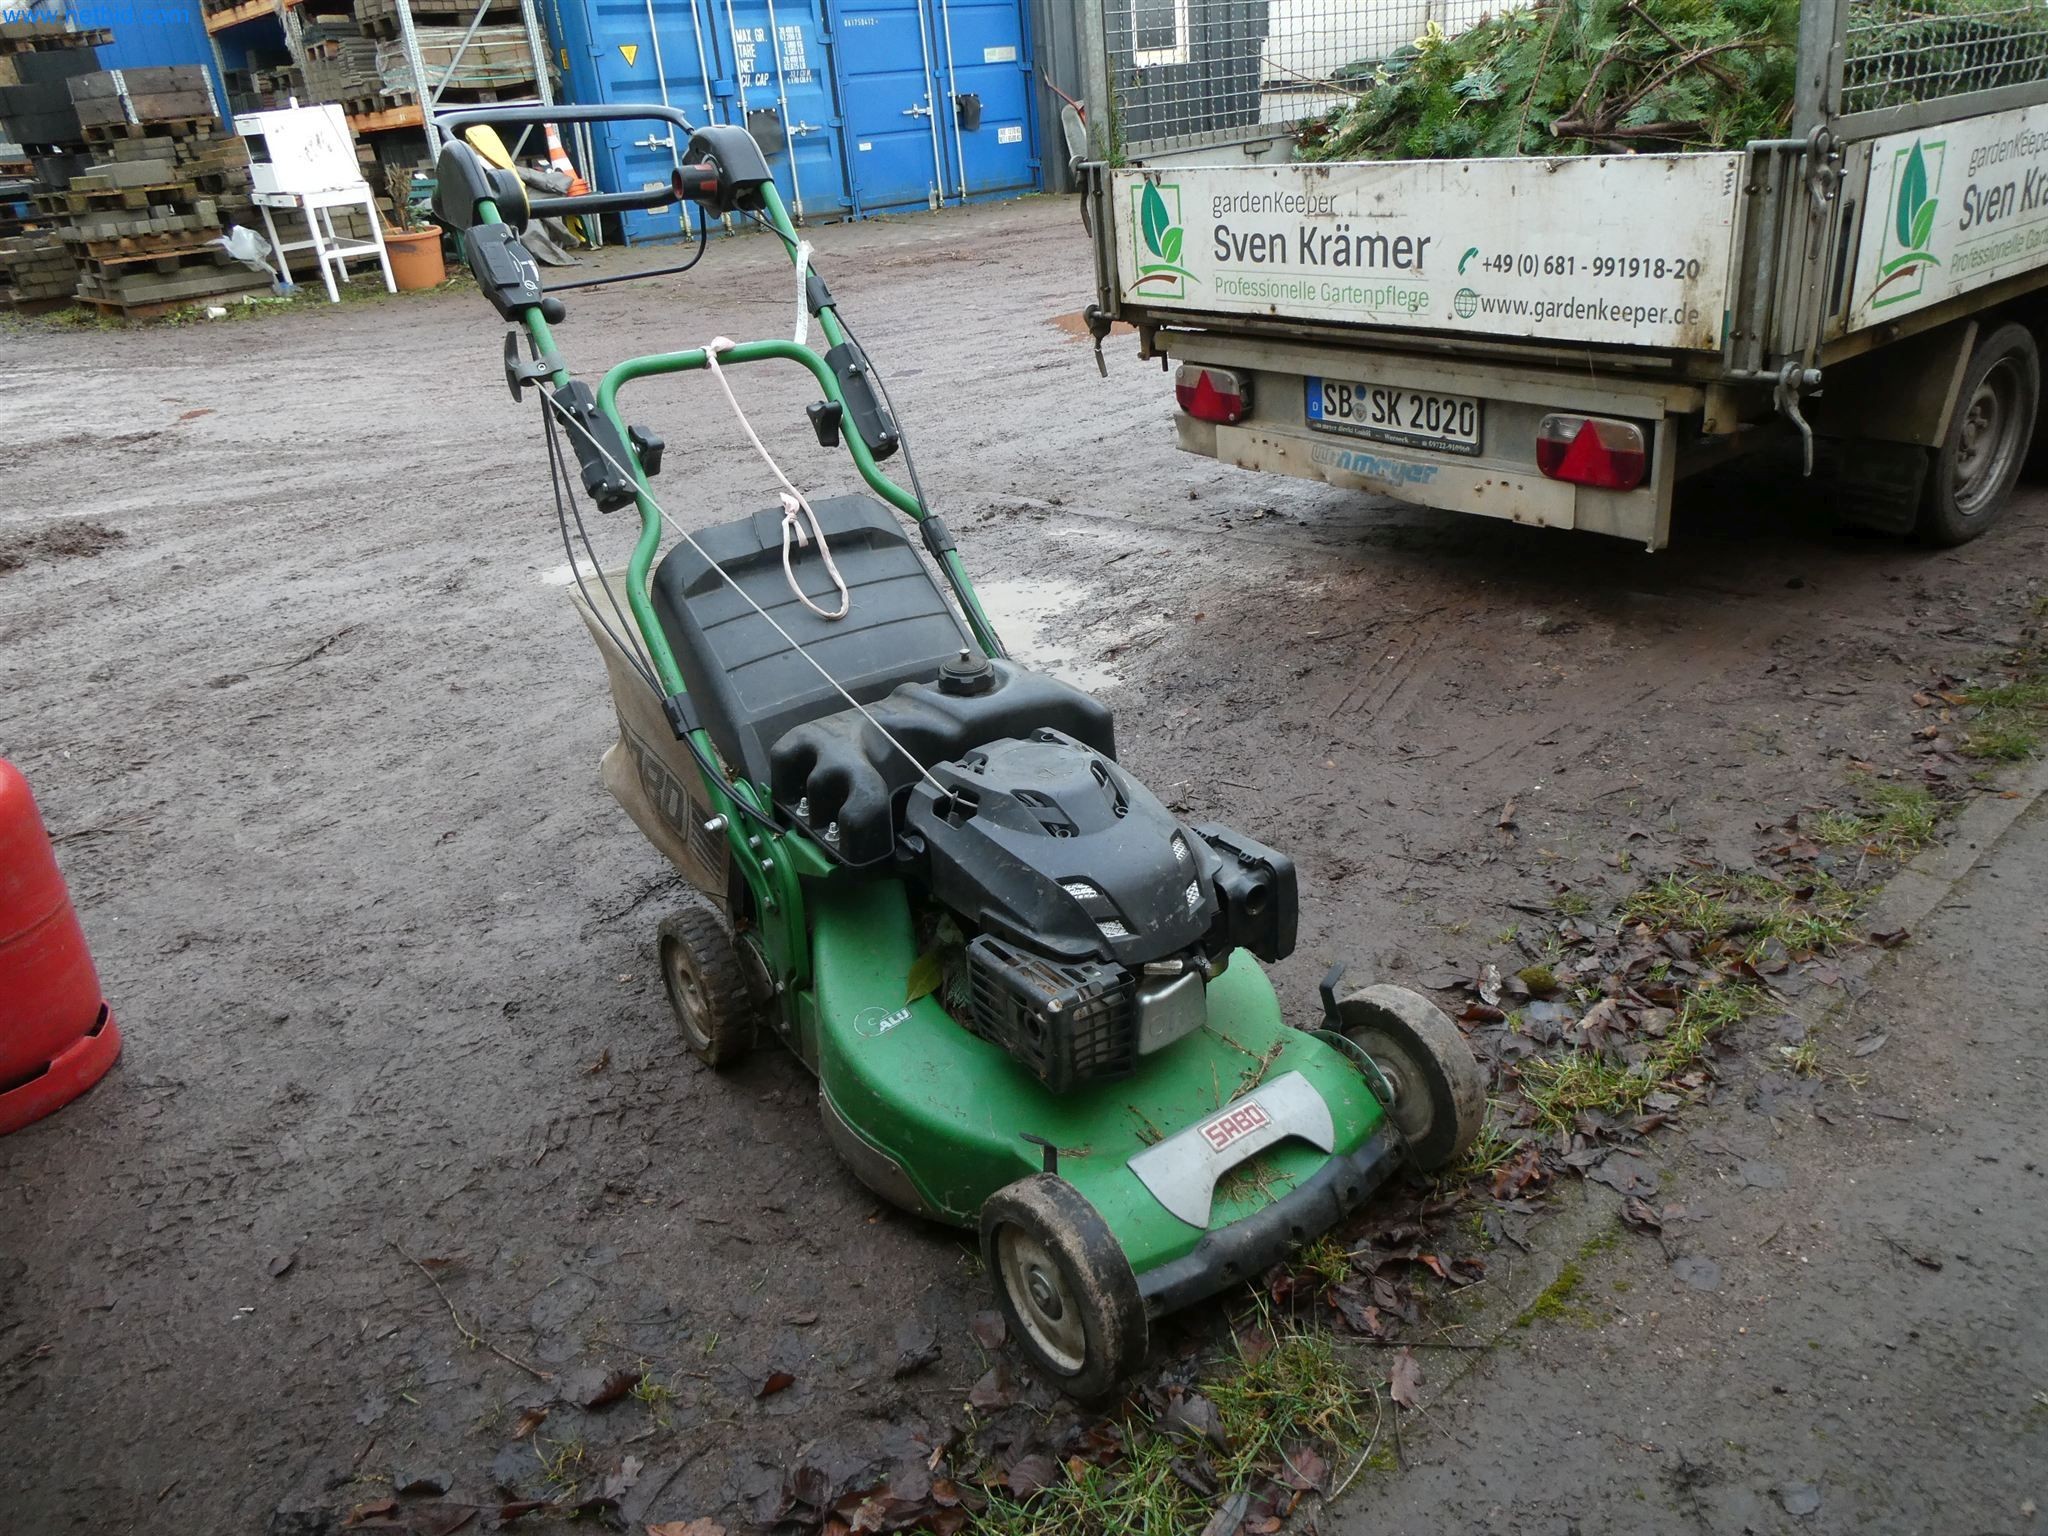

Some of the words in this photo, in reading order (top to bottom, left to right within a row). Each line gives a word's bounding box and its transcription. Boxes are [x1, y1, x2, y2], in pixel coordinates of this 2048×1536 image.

[737, 43, 756, 58] TARE
[740, 59, 754, 73] NET
[1212, 191, 1337, 218] gardenKeeper
[1959, 181, 2016, 231] Sven
[1214, 224, 1286, 263] Sven
[1300, 224, 1431, 270] Krämer
[1951, 231, 2024, 275] Professionelle
[1482, 254, 1512, 274] +49
[1518, 254, 1538, 277] (0)
[1544, 256, 1575, 276] 681
[1593, 257, 1700, 280] 991918-20
[1215, 277, 1316, 300] Professionelle
[1321, 283, 1429, 312] Gartenpflege
[1481, 297, 1700, 328] www.gardenkeeper.de
[1312, 401, 1319, 412] D
[1324, 383, 1352, 418] SB
[1372, 390, 1402, 426] SK
[1410, 395, 1475, 437] 2020
[880, 1009, 910, 1031] ALU
[1206, 1102, 1267, 1148] SABO
